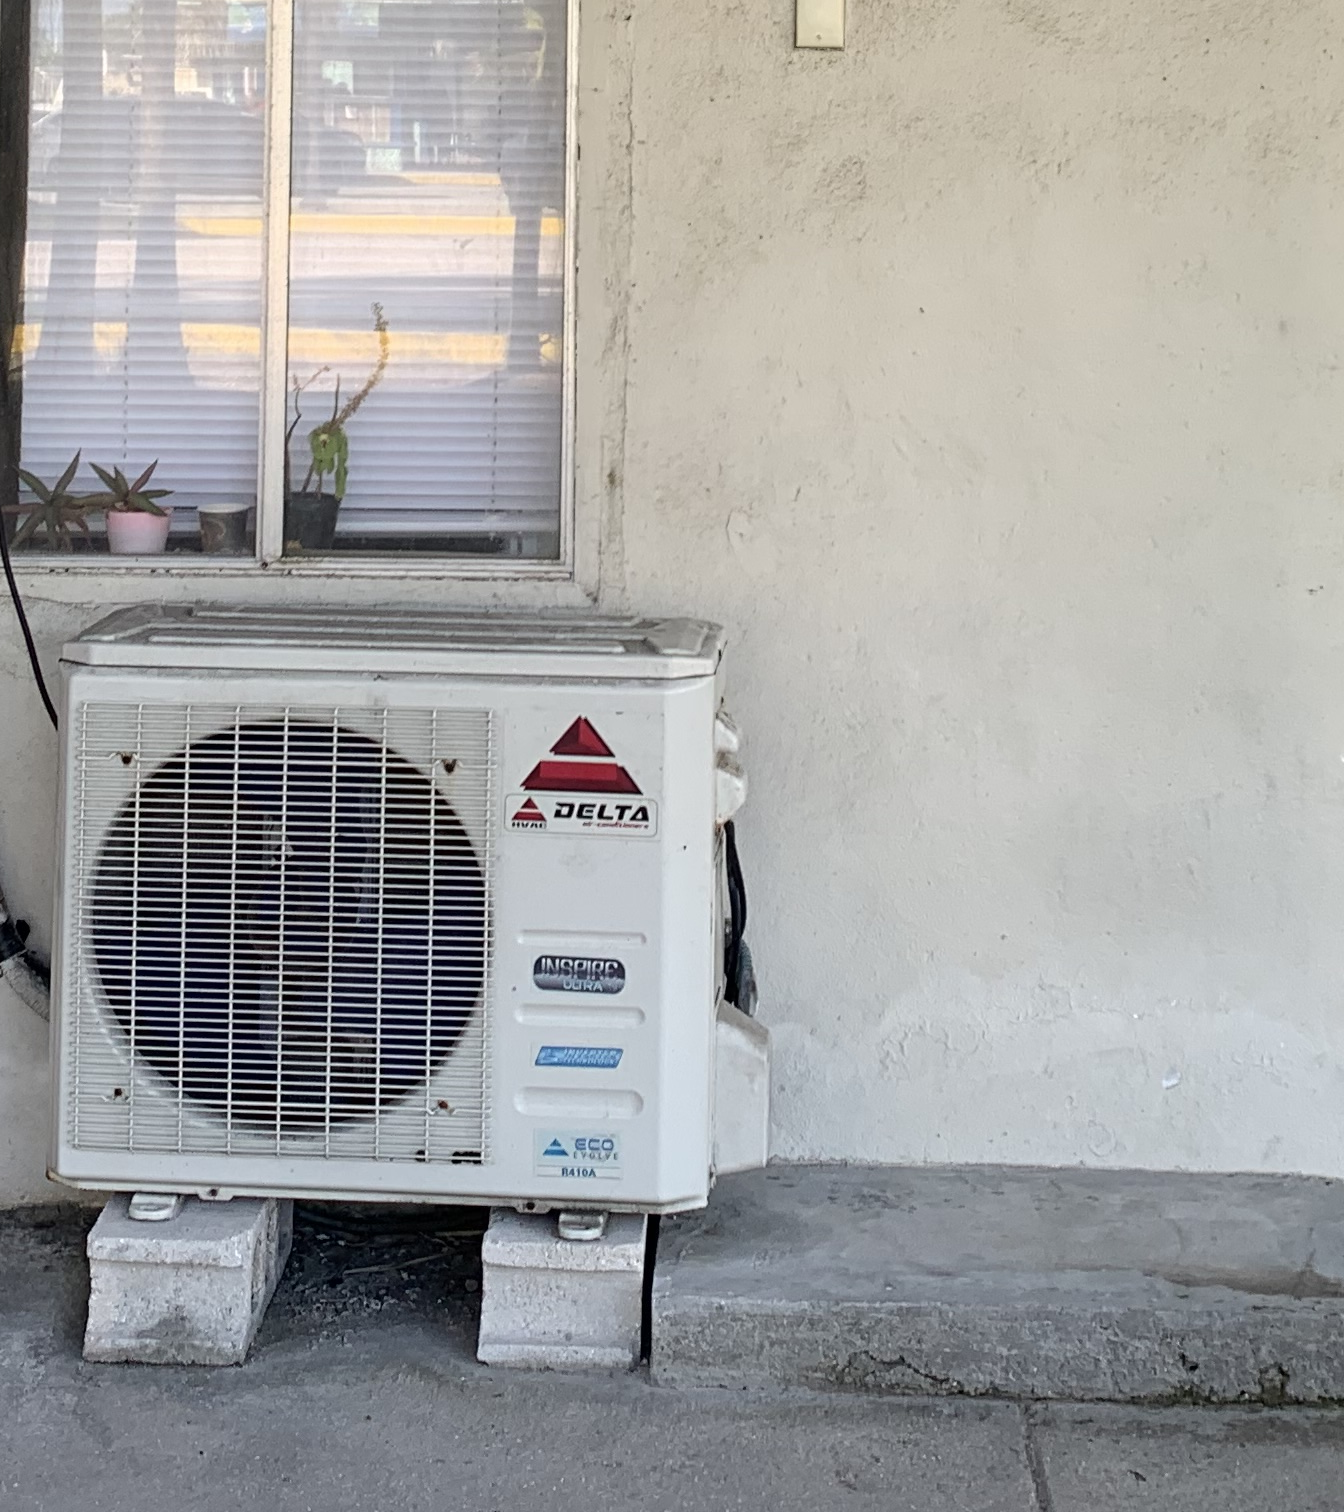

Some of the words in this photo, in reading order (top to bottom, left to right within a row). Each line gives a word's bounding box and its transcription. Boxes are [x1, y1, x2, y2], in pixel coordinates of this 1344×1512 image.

[553, 802, 650, 822] DELTA
[541, 957, 618, 981] INSPIRE
[562, 979, 604, 992] ULTRA
[574, 1138, 614, 1151] ECO
[573, 1151, 619, 1160] EVOLVE
[561, 1167, 597, 1178] R410A
